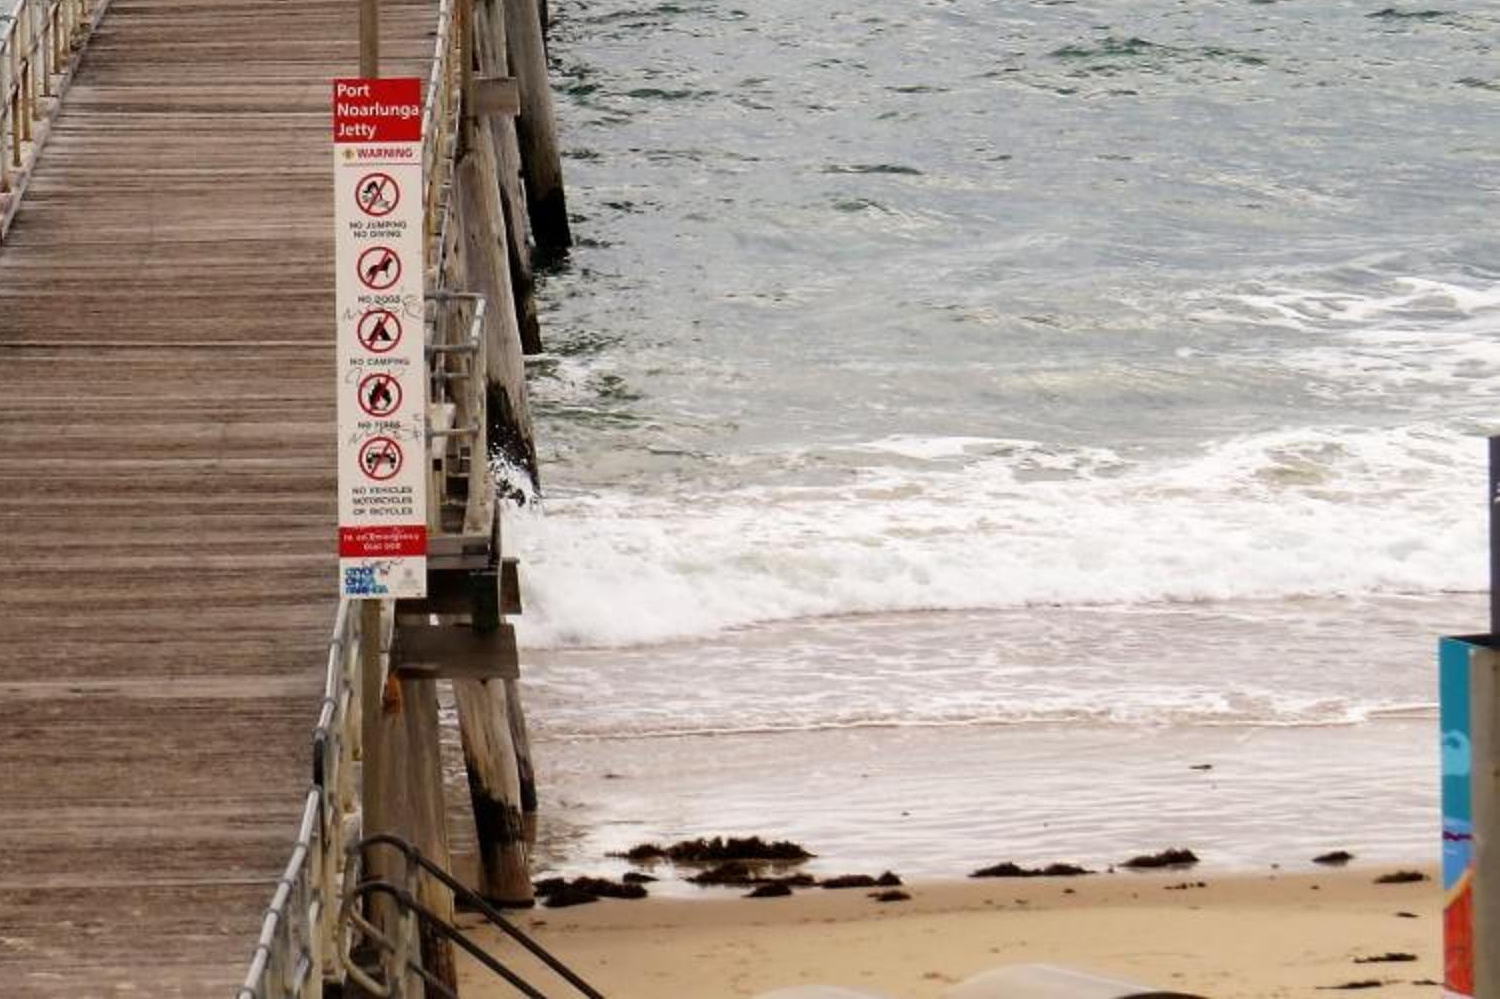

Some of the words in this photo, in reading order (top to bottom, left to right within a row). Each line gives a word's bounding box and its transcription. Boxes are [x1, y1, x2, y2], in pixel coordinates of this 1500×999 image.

[337, 83, 370, 97] Port
[337, 102, 419, 120] Noarlunga
[338, 122, 377, 140] Jetty
[357, 148, 413, 158] WARNING
[349, 221, 363, 229] NO
[366, 221, 407, 229] JUMPING
[367, 357, 411, 366] CAMPING
[370, 486, 412, 494] VEHICLES
[352, 496, 412, 505] MOTORCYCLES
[369, 506, 412, 515] BICYCLES
